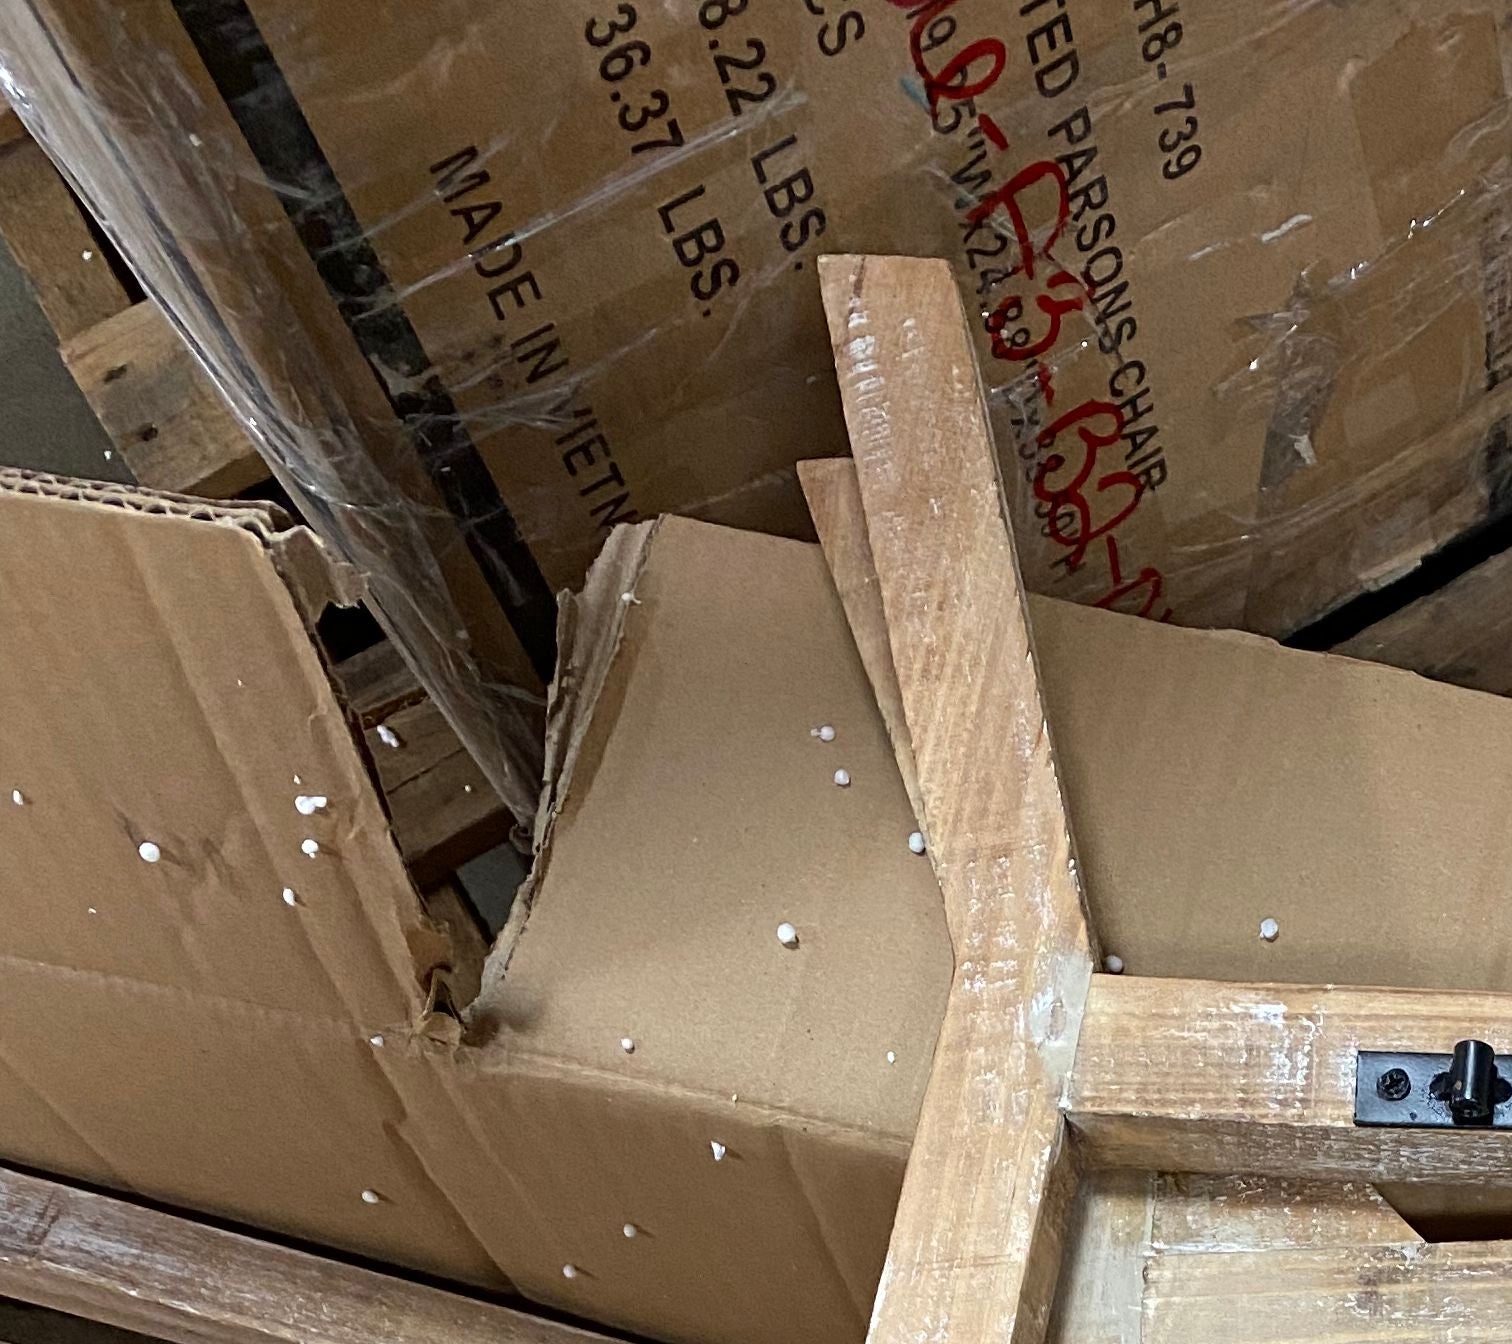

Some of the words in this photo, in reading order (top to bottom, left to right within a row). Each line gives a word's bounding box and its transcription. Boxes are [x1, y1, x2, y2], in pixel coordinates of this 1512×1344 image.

[430, 145, 542, 321] MADE
[511, 323, 570, 384] IN
[585, 3, 684, 155] 36.37
[657, 185, 740, 317] LBS.
[751, 134, 827, 270] LBS.
